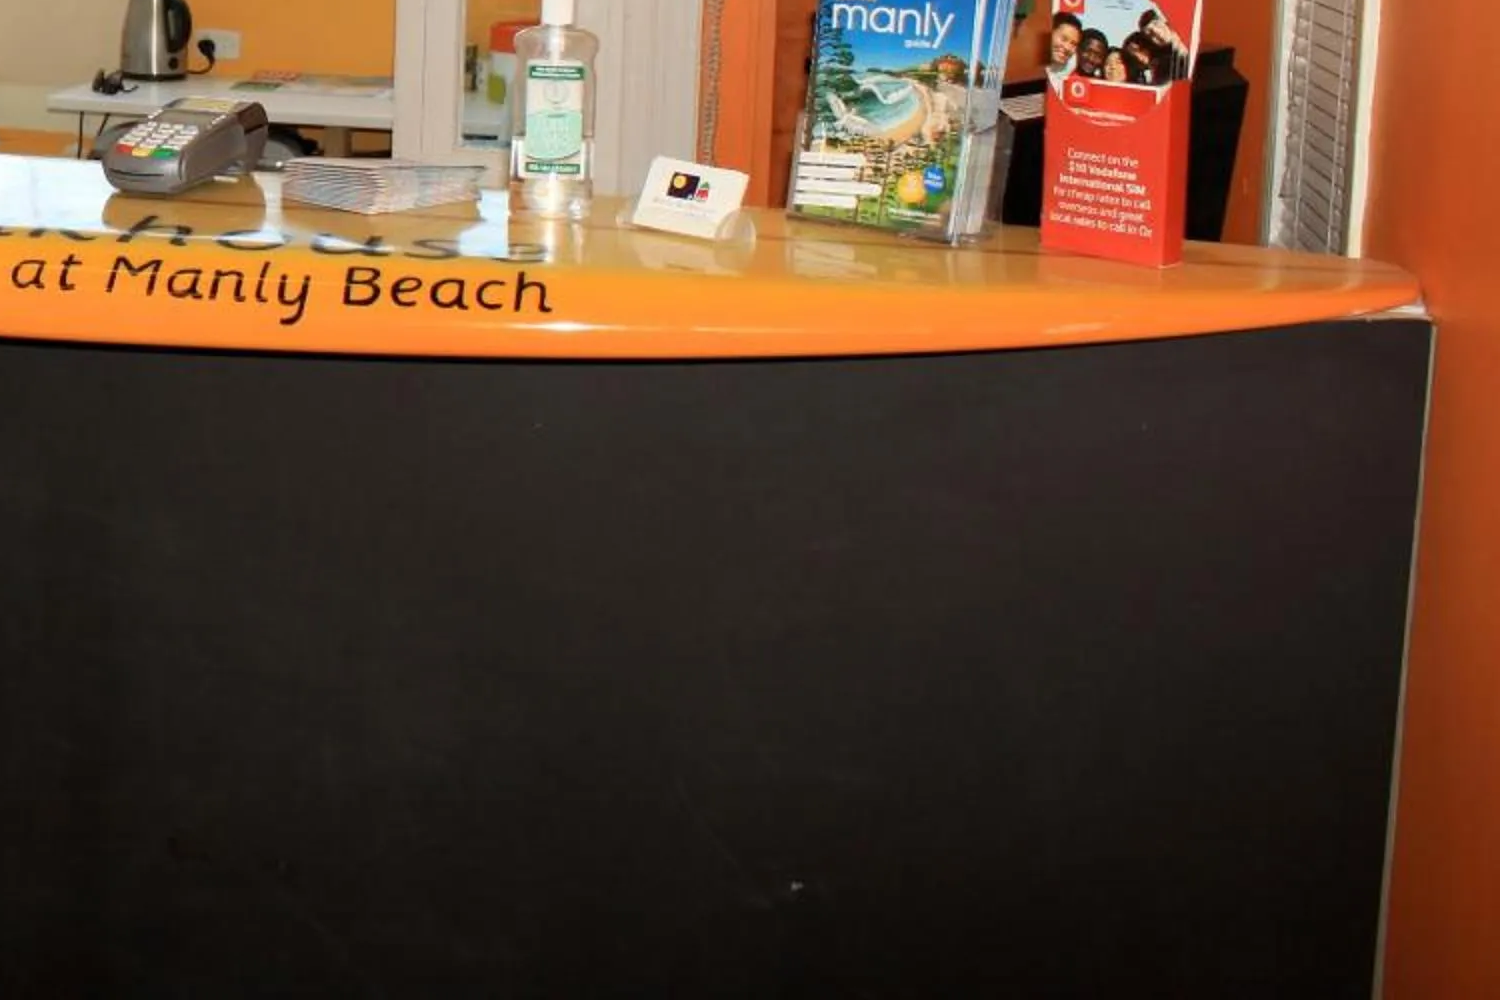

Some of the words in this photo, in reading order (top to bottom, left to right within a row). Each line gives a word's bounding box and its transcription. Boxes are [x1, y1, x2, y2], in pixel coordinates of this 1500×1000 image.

[832, 1, 955, 49] manly
[1067, 147, 1106, 163] Connect
[1121, 156, 1139, 168] the
[1059, 173, 1124, 193] International
[1089, 165, 1137, 180] Vodafone
[10, 252, 82, 291] at
[104, 254, 312, 326] Manly
[342, 265, 553, 314] Beach
